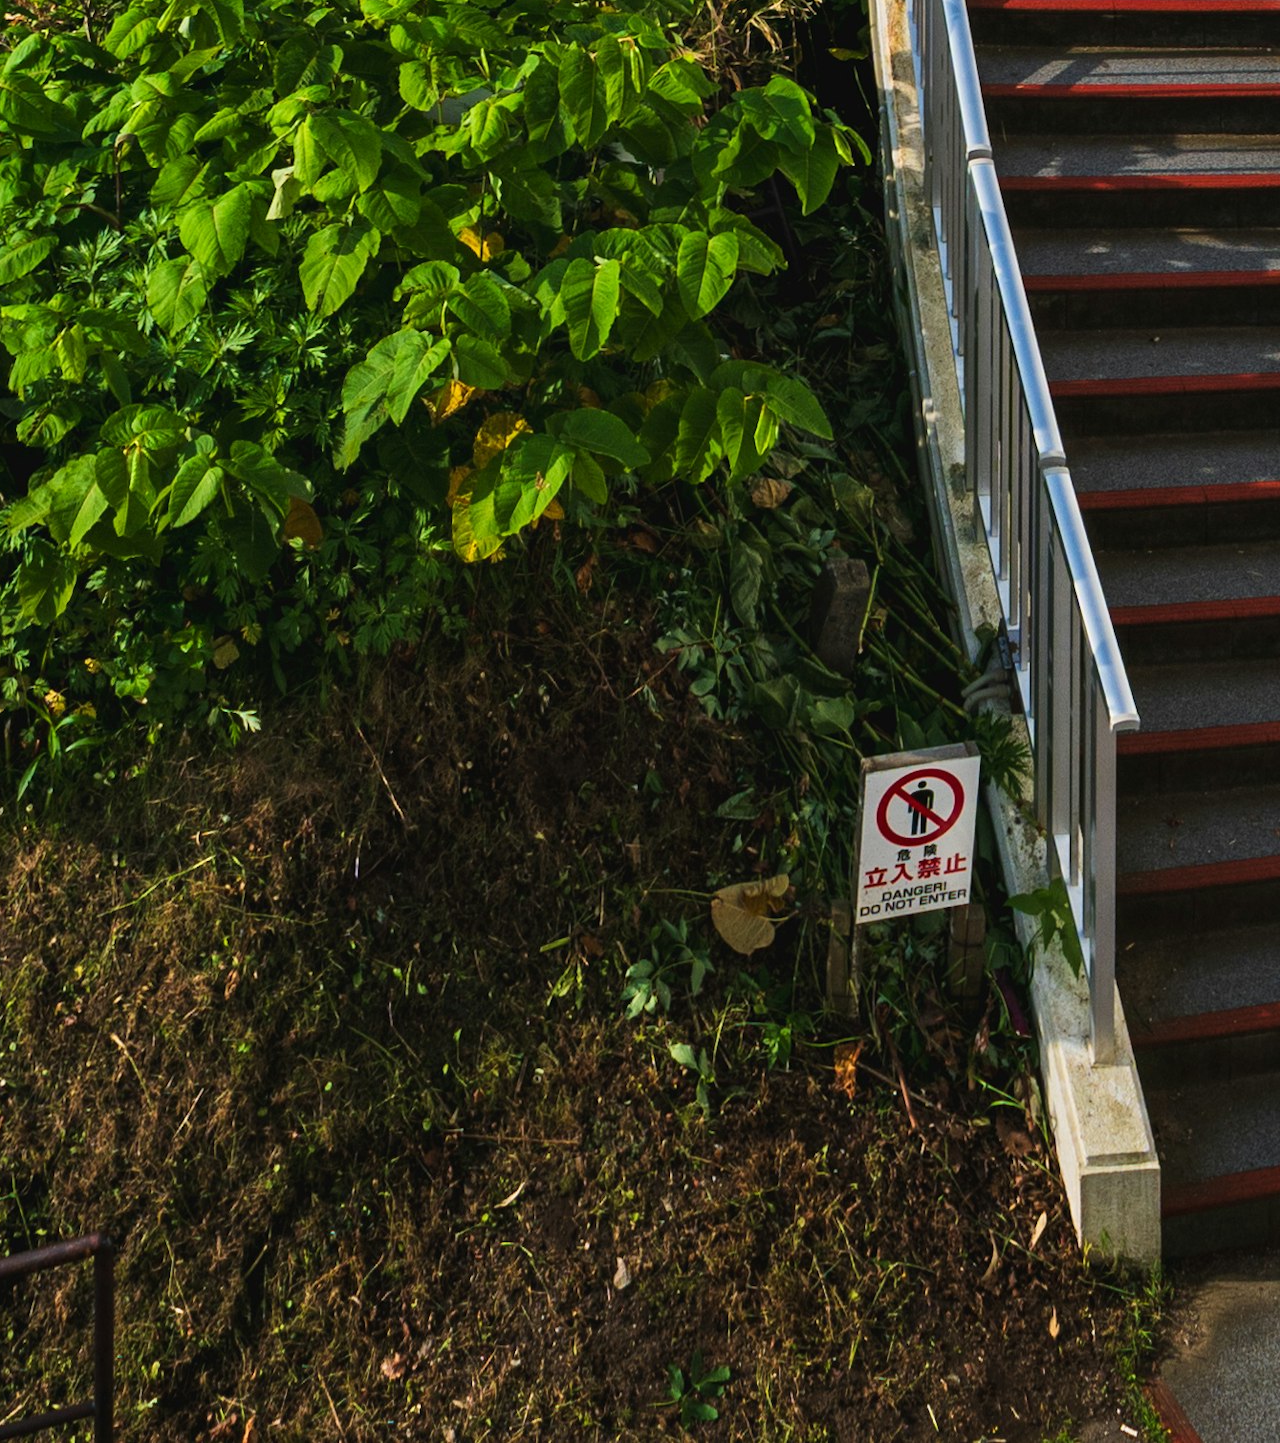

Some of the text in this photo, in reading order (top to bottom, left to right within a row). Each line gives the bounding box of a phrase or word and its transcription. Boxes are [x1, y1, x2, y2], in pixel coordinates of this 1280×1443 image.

[897, 844, 937, 861] 危険
[863, 852, 967, 889] 立入禁止
[860, 888, 967, 916] DO NOT ENTER
[882, 882, 946, 902] DANGER!
